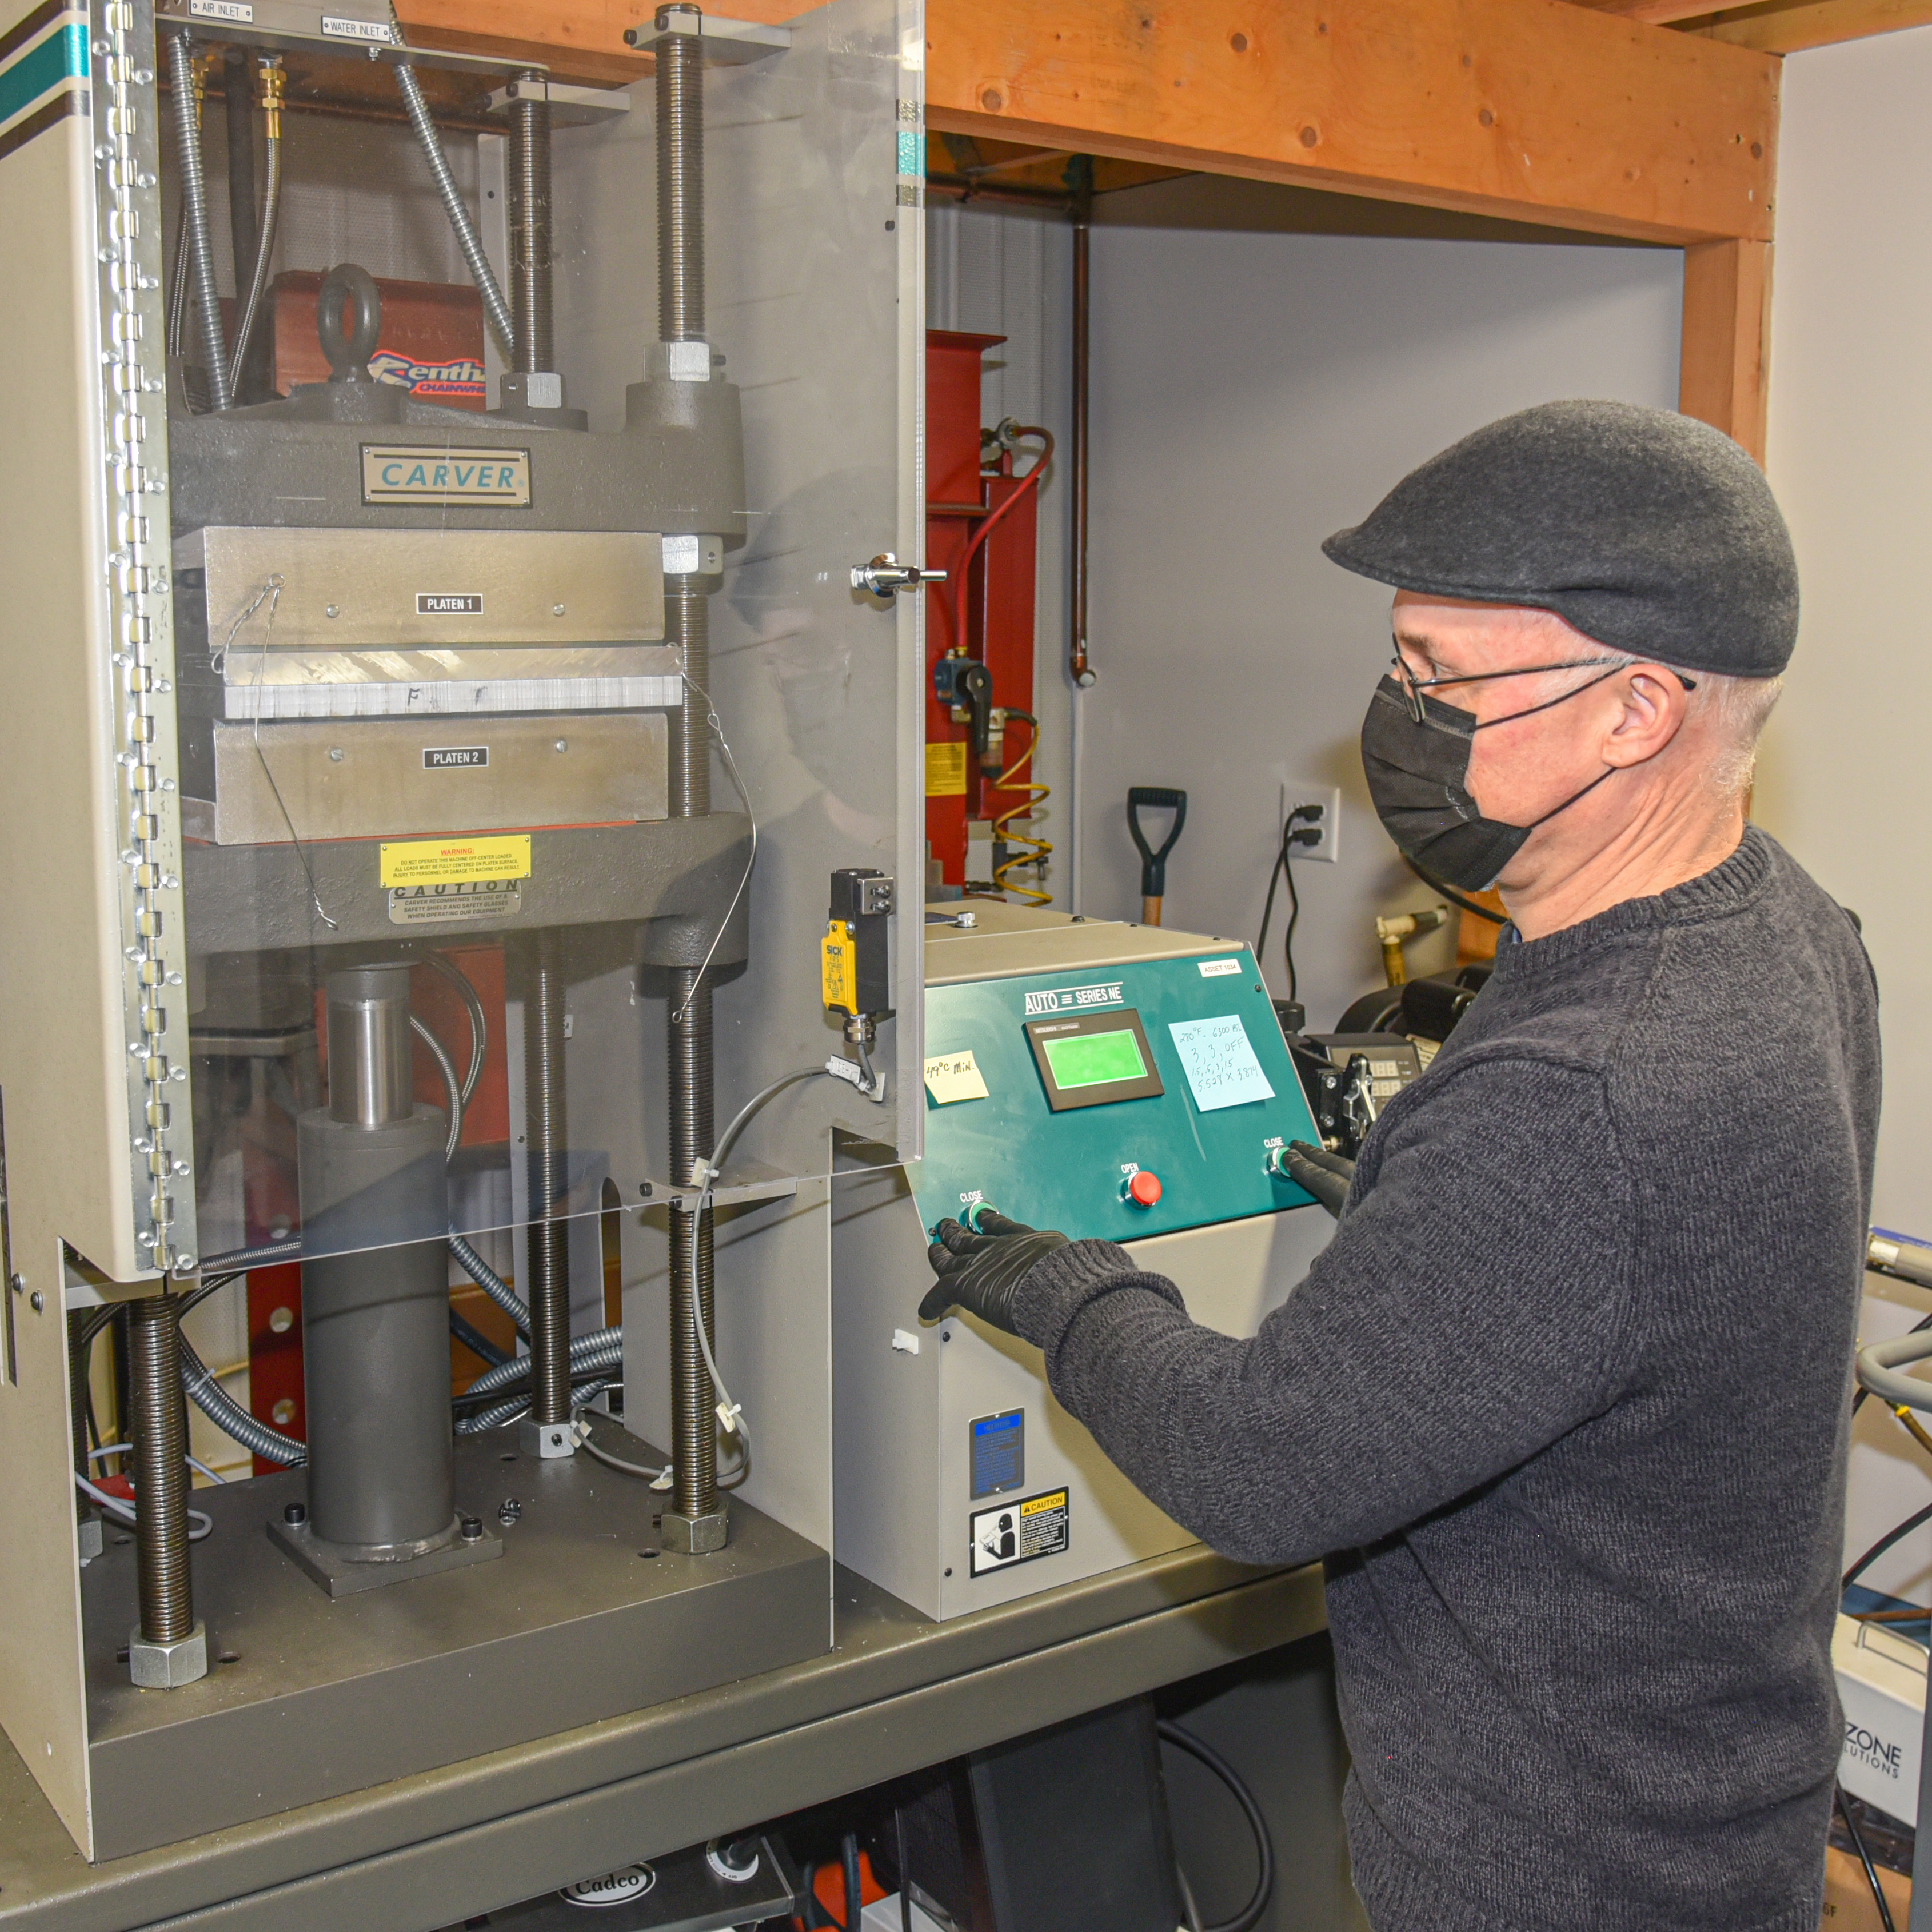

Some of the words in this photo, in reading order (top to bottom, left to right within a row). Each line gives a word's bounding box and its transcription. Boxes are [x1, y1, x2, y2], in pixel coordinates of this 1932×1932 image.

[202, 2, 214, 14] AIR
[218, 5, 239, 17] INLET
[330, 21, 356, 34] WATER
[359, 25, 380, 37] INLET
[381, 463, 514, 488] CARVER
[427, 598, 464, 610] PLATEN
[467, 599, 473, 609] 1
[407, 688, 420, 706] F
[433, 752, 470, 764] PLATEN
[473, 752, 478, 763] 2
[394, 880, 517, 897] CAUTION
[426, 909, 458, 918] OPERATING
[827, 945, 843, 956] SICK
[1025, 993, 1058, 1012] AUTO
[1075, 988, 1108, 1004] SERIES
[1108, 986, 1122, 1000] NE
[1224, 1035, 1244, 1052] OFF
[1263, 1136, 1284, 1148] CLOSE
[1121, 1162, 1139, 1173] OPEN
[960, 1189, 984, 1203] CLOSE
[1031, 1496, 1063, 1511] CAUTION
[1845, 1721, 1901, 1768] ZONE
[576, 1873, 640, 1894] Cadco
